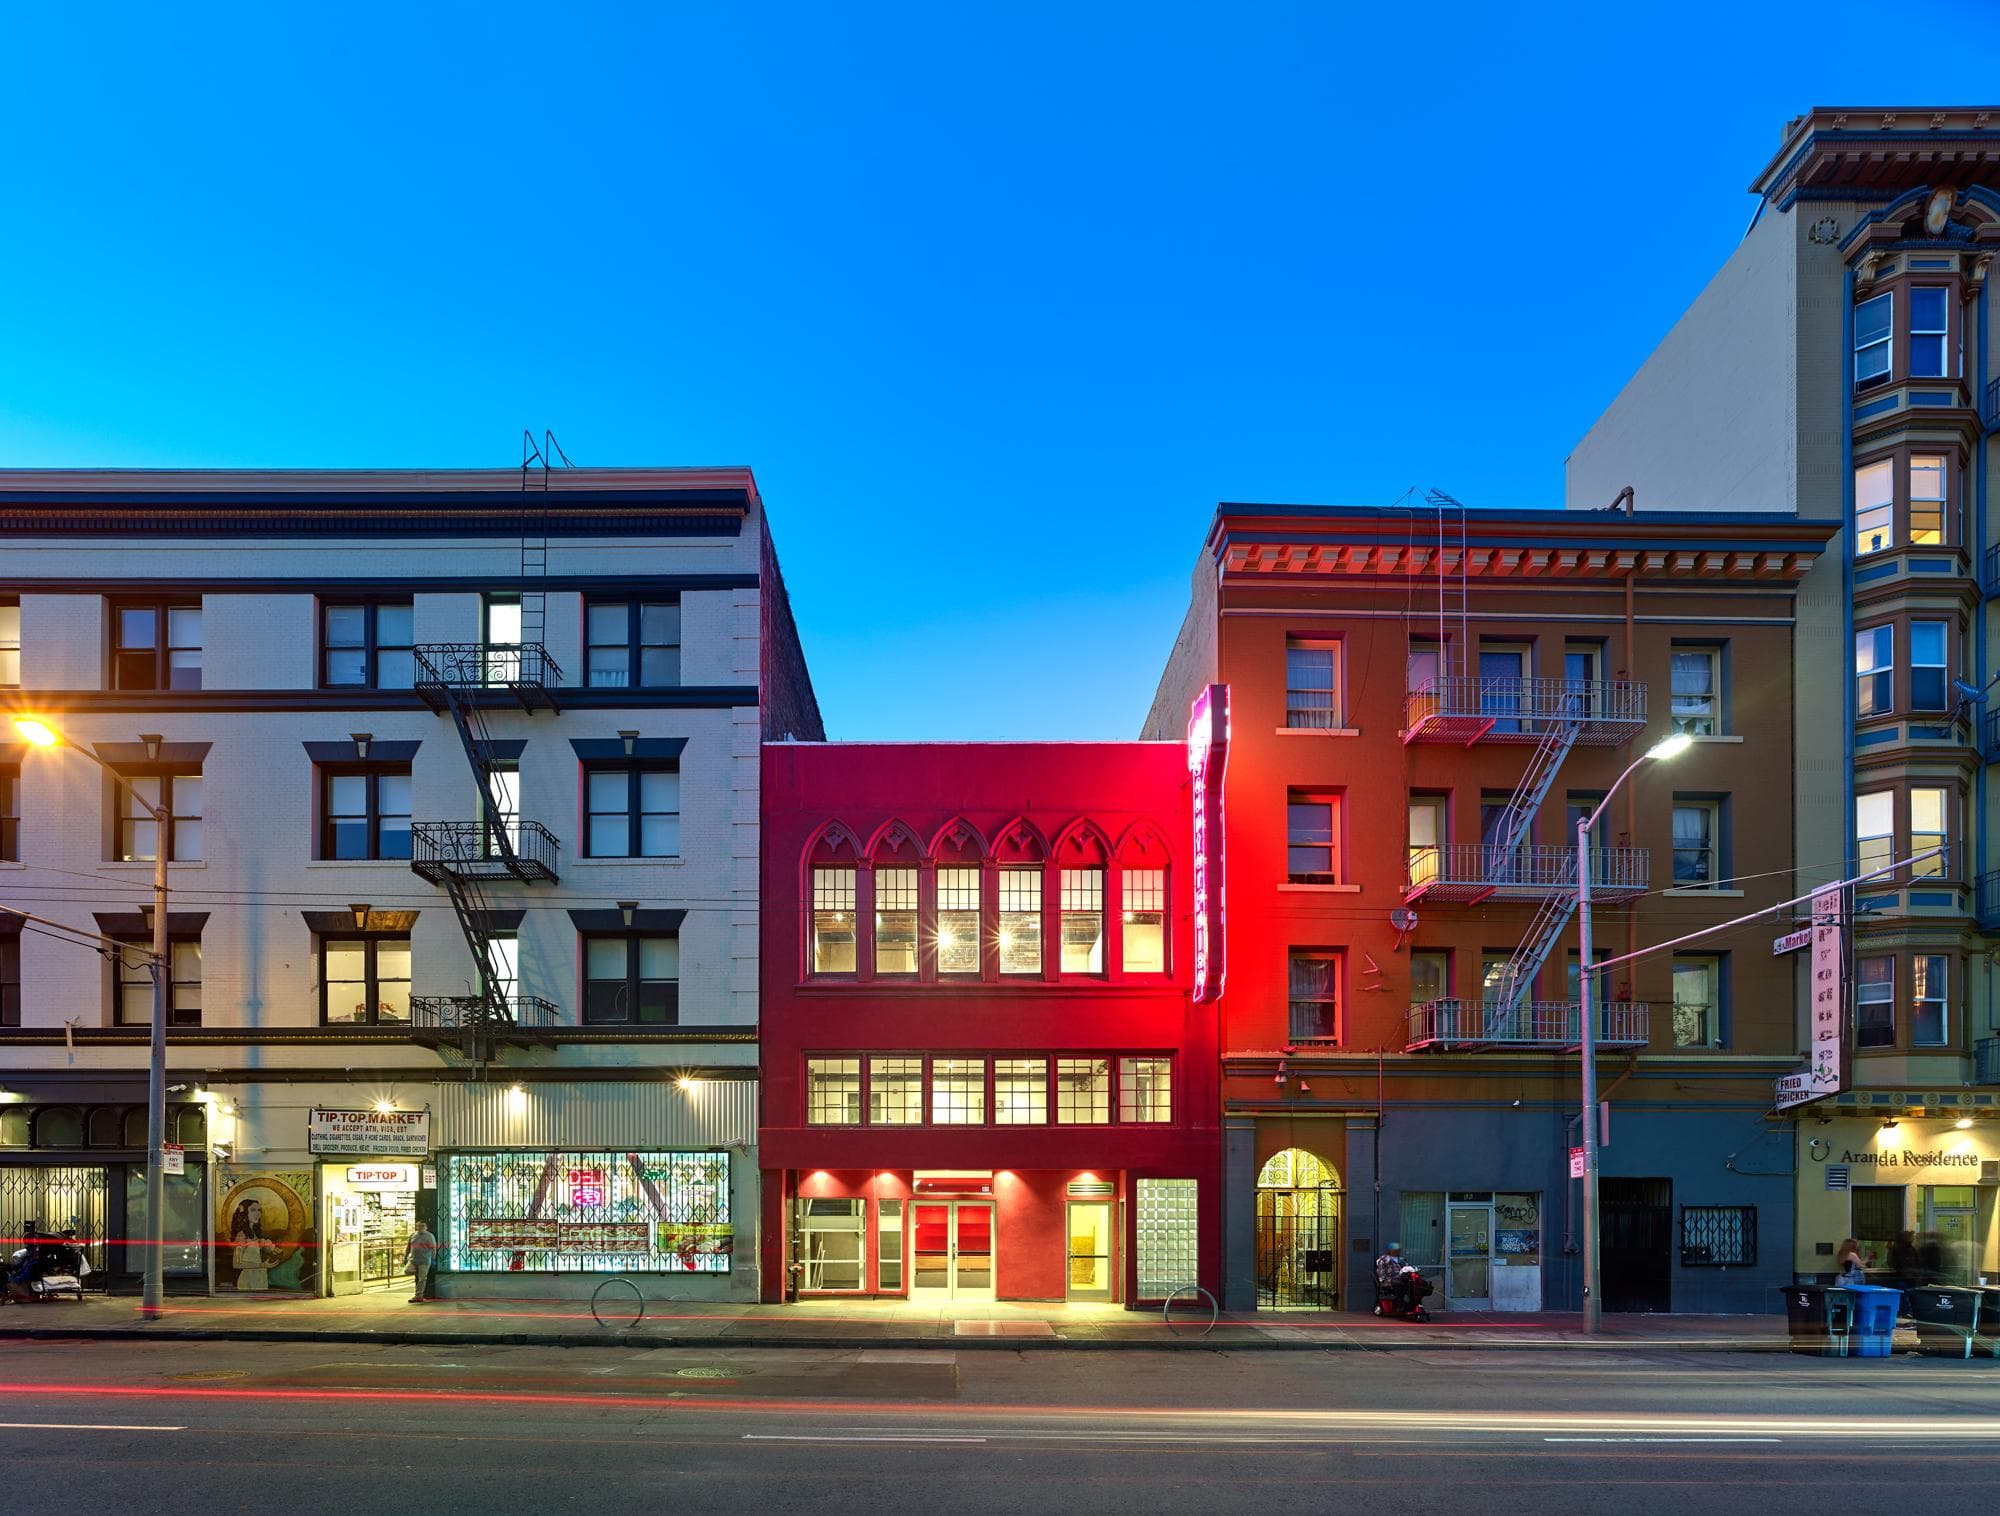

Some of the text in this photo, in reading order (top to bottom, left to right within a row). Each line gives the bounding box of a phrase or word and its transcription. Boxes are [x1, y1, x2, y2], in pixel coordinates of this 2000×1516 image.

[1780, 1078, 1801, 1090] FRIED
[1777, 1090, 1809, 1103] CHICKEN
[381, 1126, 396, 1134] VISA,
[1842, 1150, 1978, 1167] Aranda Residence
[425, 1175, 435, 1183] EBT
[569, 1170, 604, 1185] DELI
